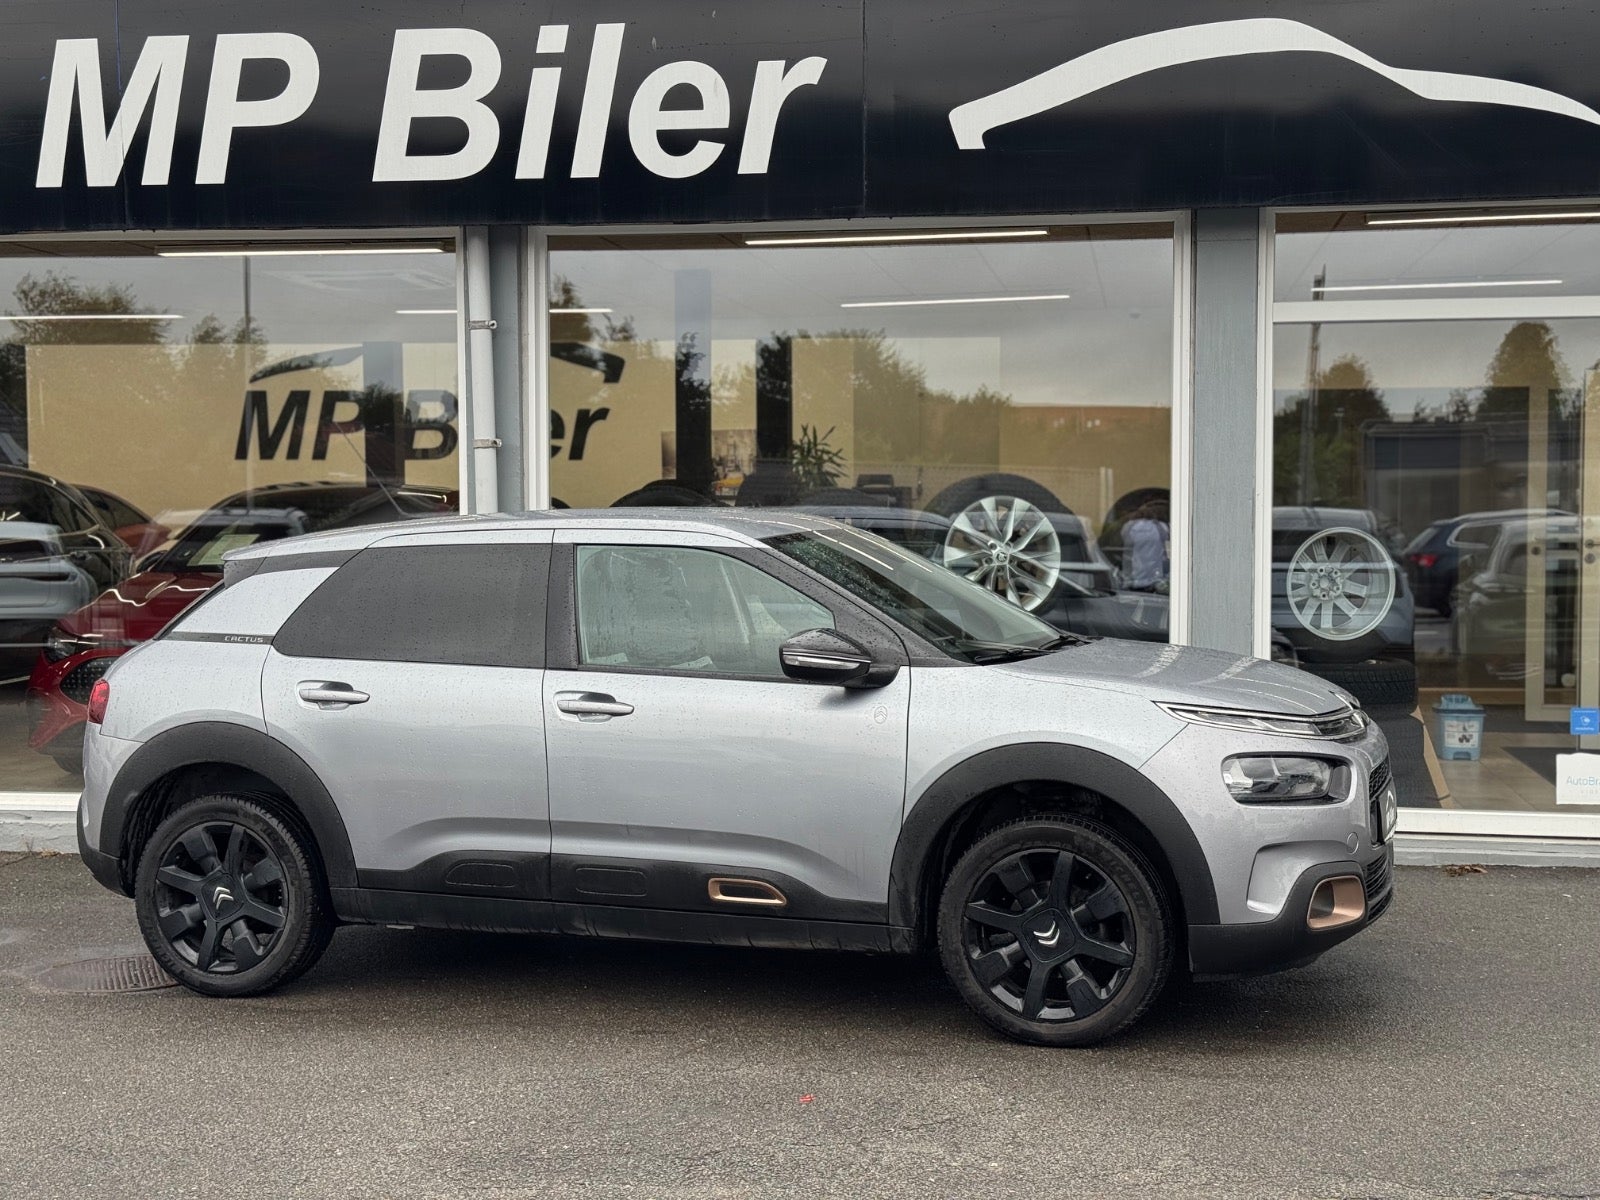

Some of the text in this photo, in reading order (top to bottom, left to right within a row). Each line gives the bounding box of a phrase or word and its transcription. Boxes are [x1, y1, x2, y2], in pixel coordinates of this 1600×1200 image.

[35, 23, 828, 189] MP Biler
[234, 389, 366, 461] MP
[224, 635, 264, 643] CACTUS
